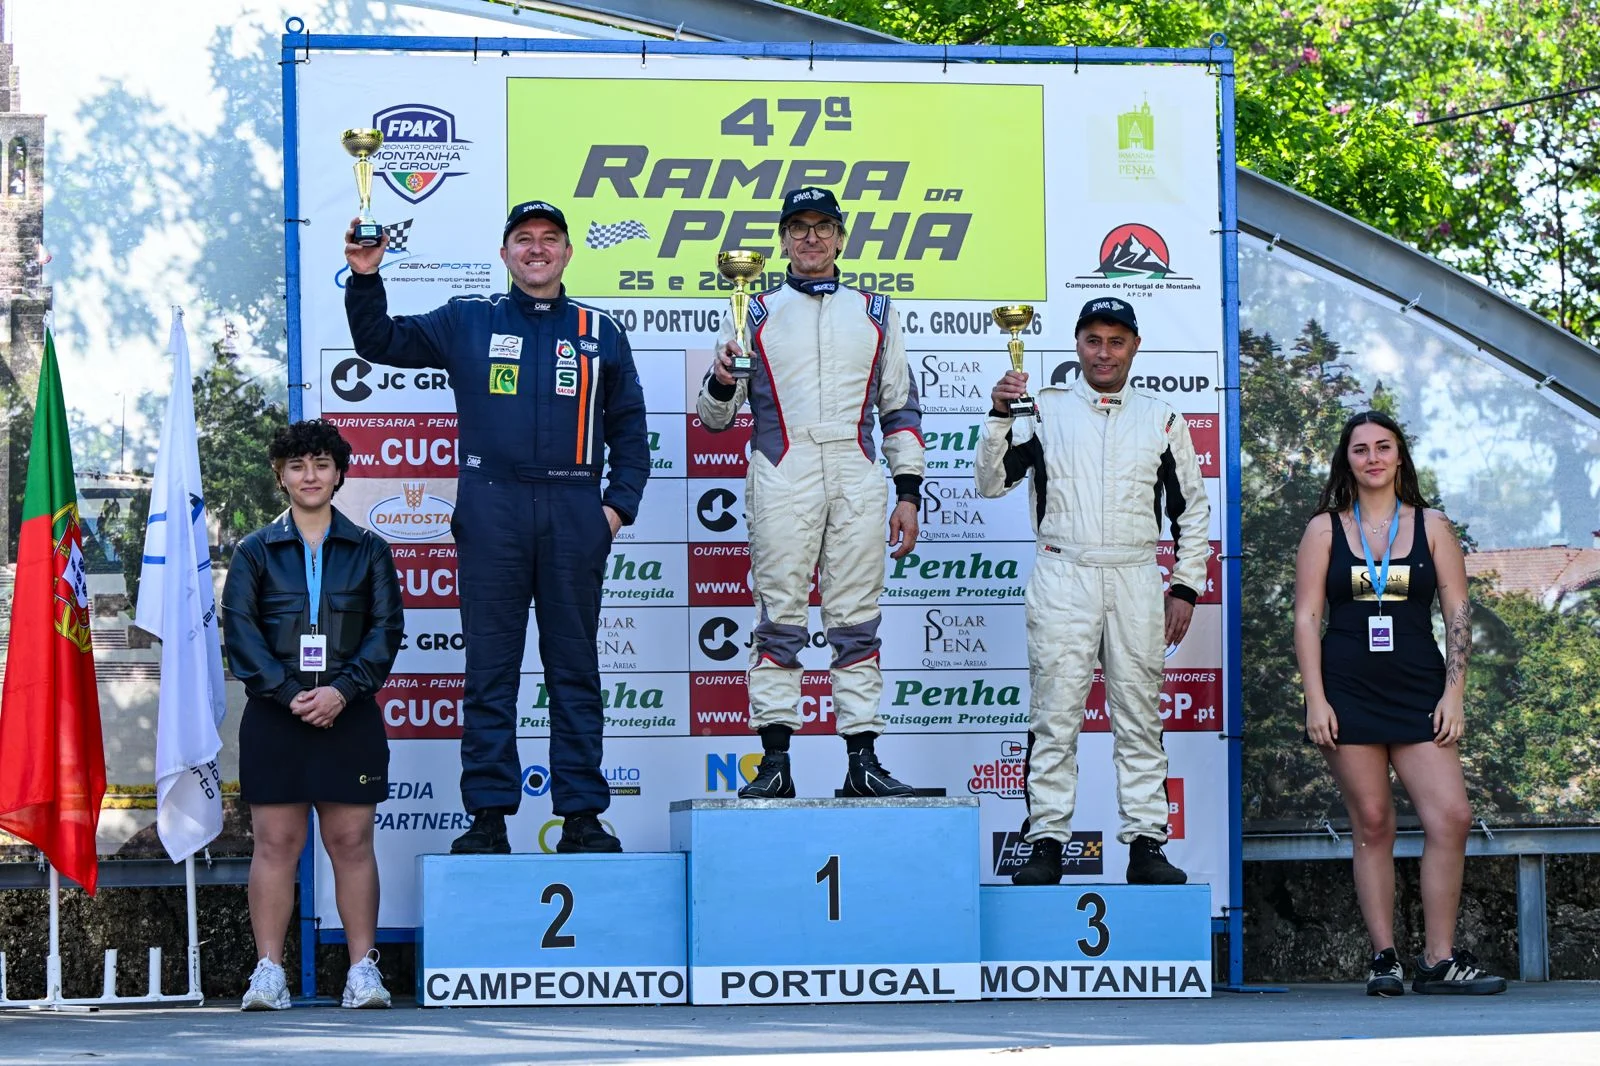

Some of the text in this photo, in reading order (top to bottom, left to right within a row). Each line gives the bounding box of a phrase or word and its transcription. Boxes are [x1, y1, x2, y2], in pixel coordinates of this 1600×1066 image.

[386, 120, 441, 138] FPAK
[379, 162, 450, 171] JC GROUP
[924, 189, 963, 202] DA
[657, 210, 972, 261] PEHA
[618, 271, 655, 291] 25
[668, 276, 684, 291] e
[842, 273, 914, 292] 2026
[1065, 282, 1110, 290] Campeonato
[1123, 282, 1153, 290] Portugal
[643, 309, 727, 333] PORTUG
[930, 311, 993, 334] GROUP
[922, 355, 983, 386] SOLAR
[377, 373, 406, 390] JC
[919, 371, 983, 398] PENA
[1130, 376, 1209, 393] GROUP
[329, 418, 416, 428] OURIVESARIA
[921, 498, 985, 525] PENA
[694, 546, 750, 556] OURIVES
[890, 552, 1018, 580] Penha
[601, 587, 675, 601] Protegida
[881, 587, 950, 599] Paisagem
[925, 609, 986, 641] SOLAR
[597, 640, 636, 655] ENA
[923, 626, 987, 653] PENA
[892, 679, 1020, 706] Penha
[602, 716, 676, 729] Protegida
[605, 765, 640, 781] uto
[388, 782, 434, 799] EDIA
[374, 813, 474, 830] PARTNERS
[815, 855, 842, 922] 1
[540, 882, 577, 948] 2
[1076, 891, 1110, 958] 3
[426, 965, 1207, 1001] CAMPEONATO PORTUGAL MONTANHA
